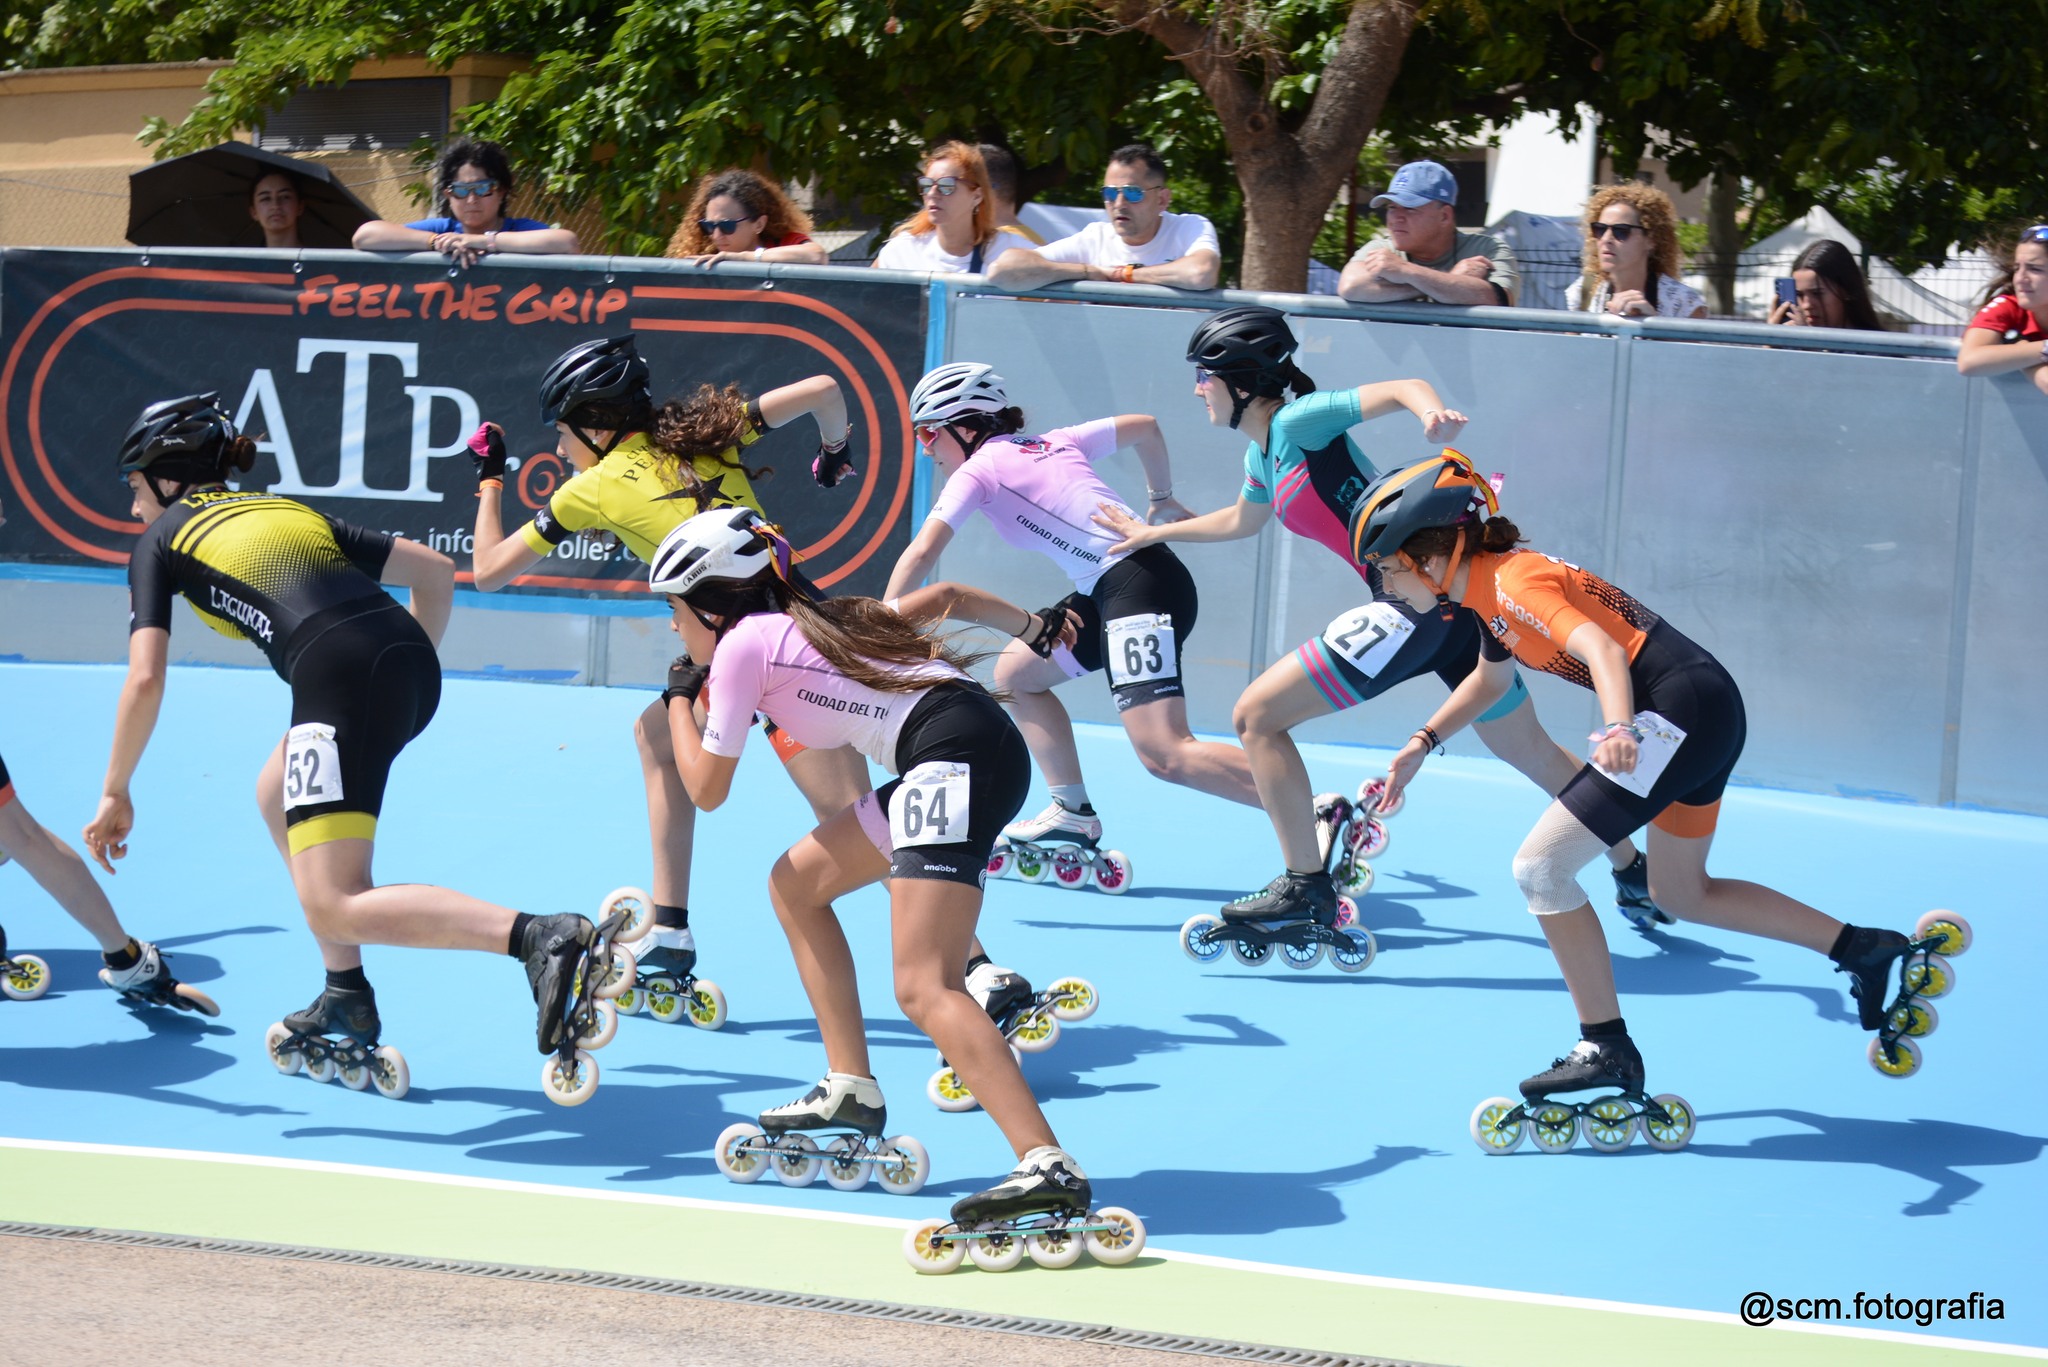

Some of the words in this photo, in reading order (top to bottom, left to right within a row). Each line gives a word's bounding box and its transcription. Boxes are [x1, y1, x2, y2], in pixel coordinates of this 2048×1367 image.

[297, 274, 412, 319] FEEL
[413, 281, 502, 321] THE
[505, 283, 628, 325] GRIP
[1016, 515, 1052, 541] CIUDAD
[1051, 537, 1070, 552] DEL
[1070, 545, 1102, 565] TURIA
[1123, 634, 1163, 677] 63
[1333, 614, 1389, 661] 27
[796, 688, 846, 713] CIUDAD
[848, 701, 870, 717] DEL
[286, 748, 324, 799] 52
[903, 786, 949, 839] 64
